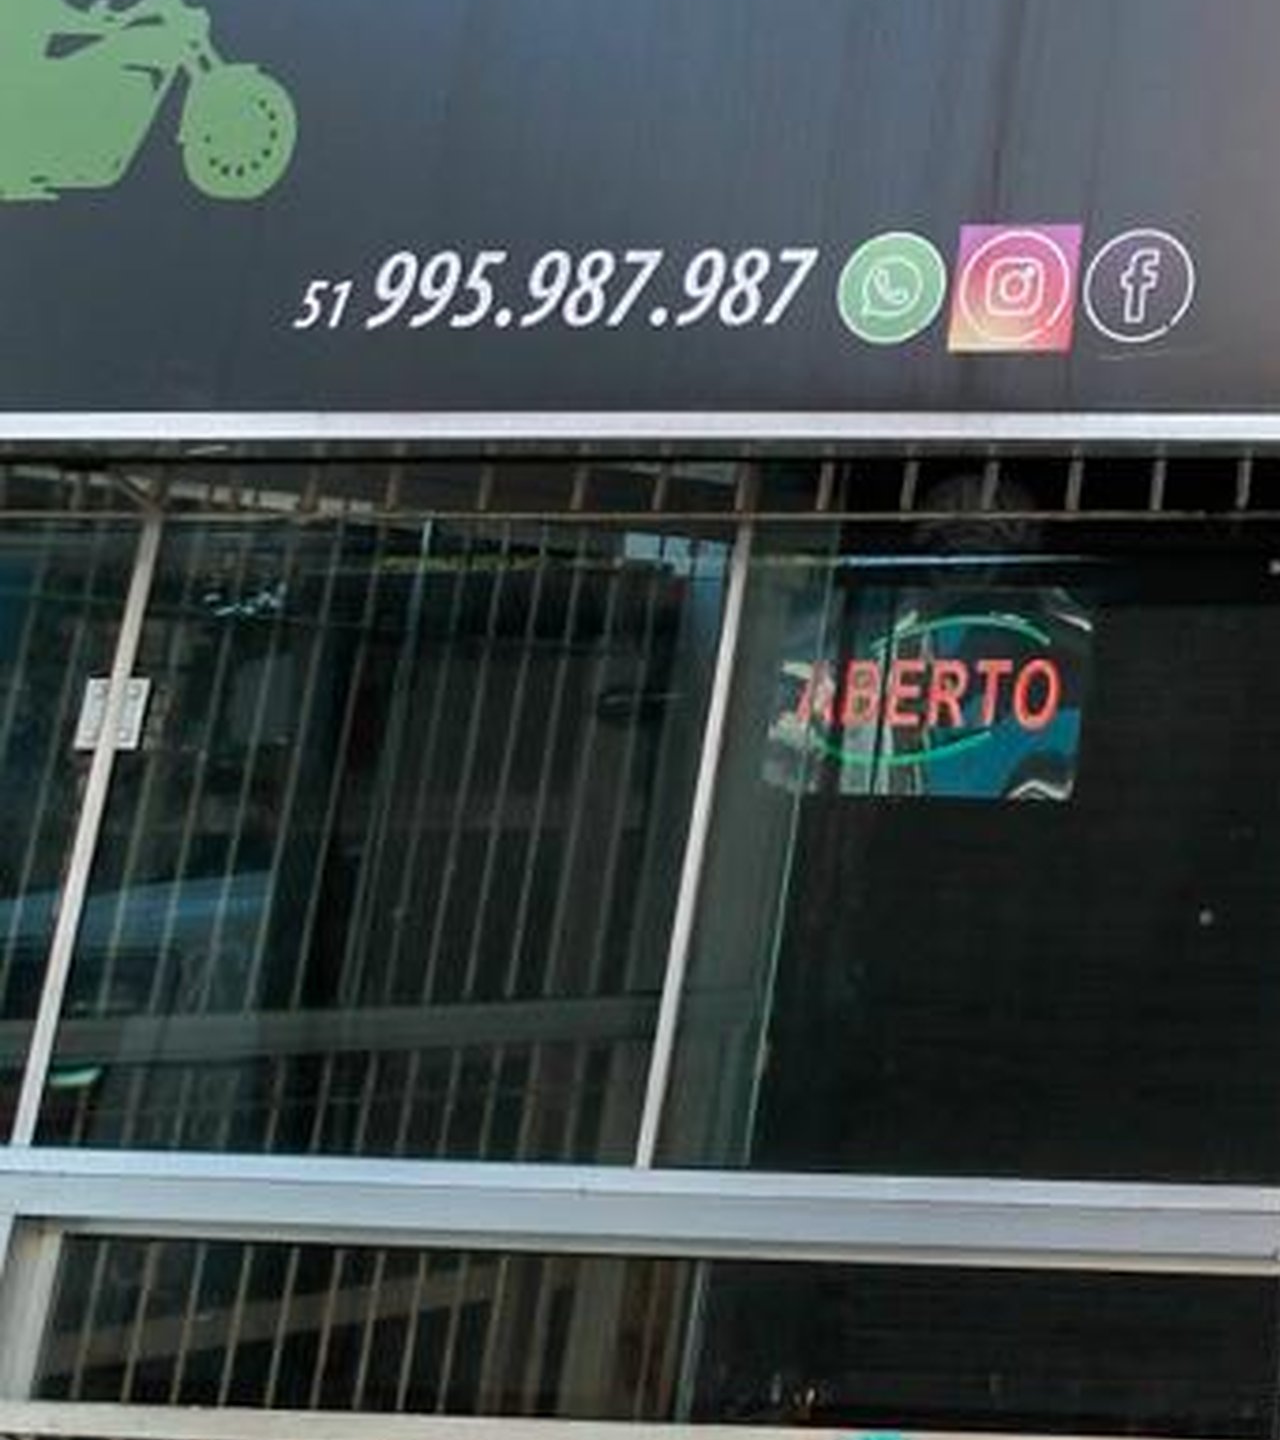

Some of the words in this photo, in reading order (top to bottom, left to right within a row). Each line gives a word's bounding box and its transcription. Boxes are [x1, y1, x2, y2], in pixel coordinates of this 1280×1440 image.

[293, 280, 352, 328] 51
[365, 247, 820, 329] 995.987.987
[795, 658, 1061, 730] ABERTO
